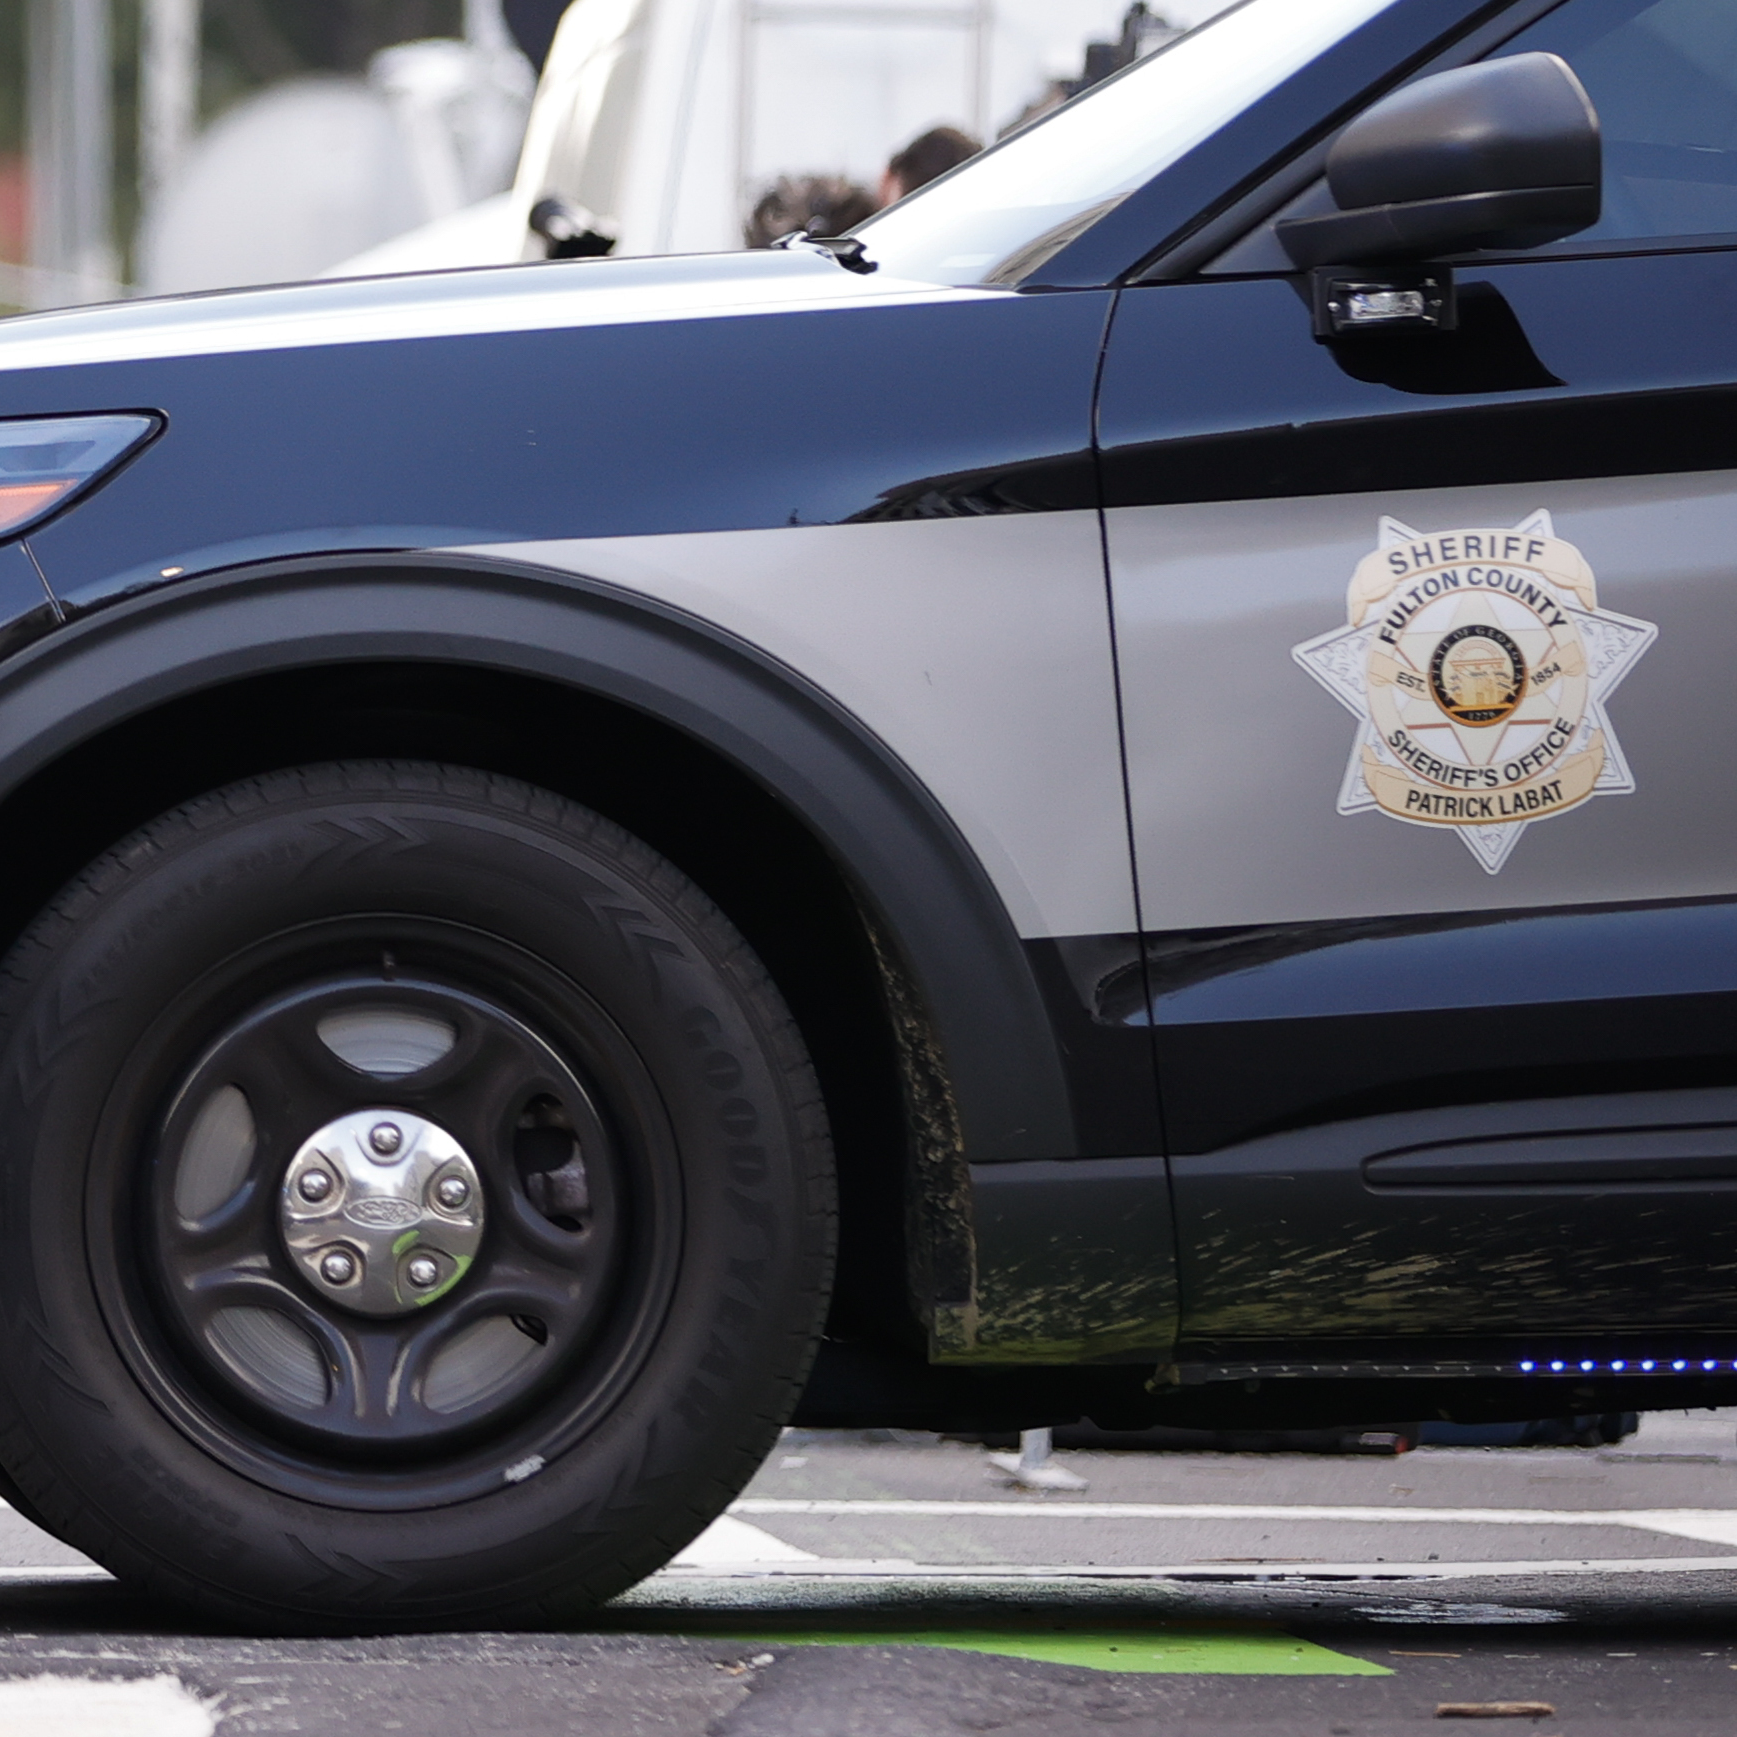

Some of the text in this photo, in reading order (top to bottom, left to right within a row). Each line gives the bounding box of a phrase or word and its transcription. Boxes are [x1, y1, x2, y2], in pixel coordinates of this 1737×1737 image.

[1388, 535, 1546, 576] SHERIFF
[1380, 566, 1568, 646] FULTON COUNTY
[1395, 671, 1426, 693] EST.
[1530, 662, 1561, 687] 1854
[1388, 717, 1576, 788] SHERIFF'S OFFICE
[1404, 780, 1565, 818] PATRICK LABAT
